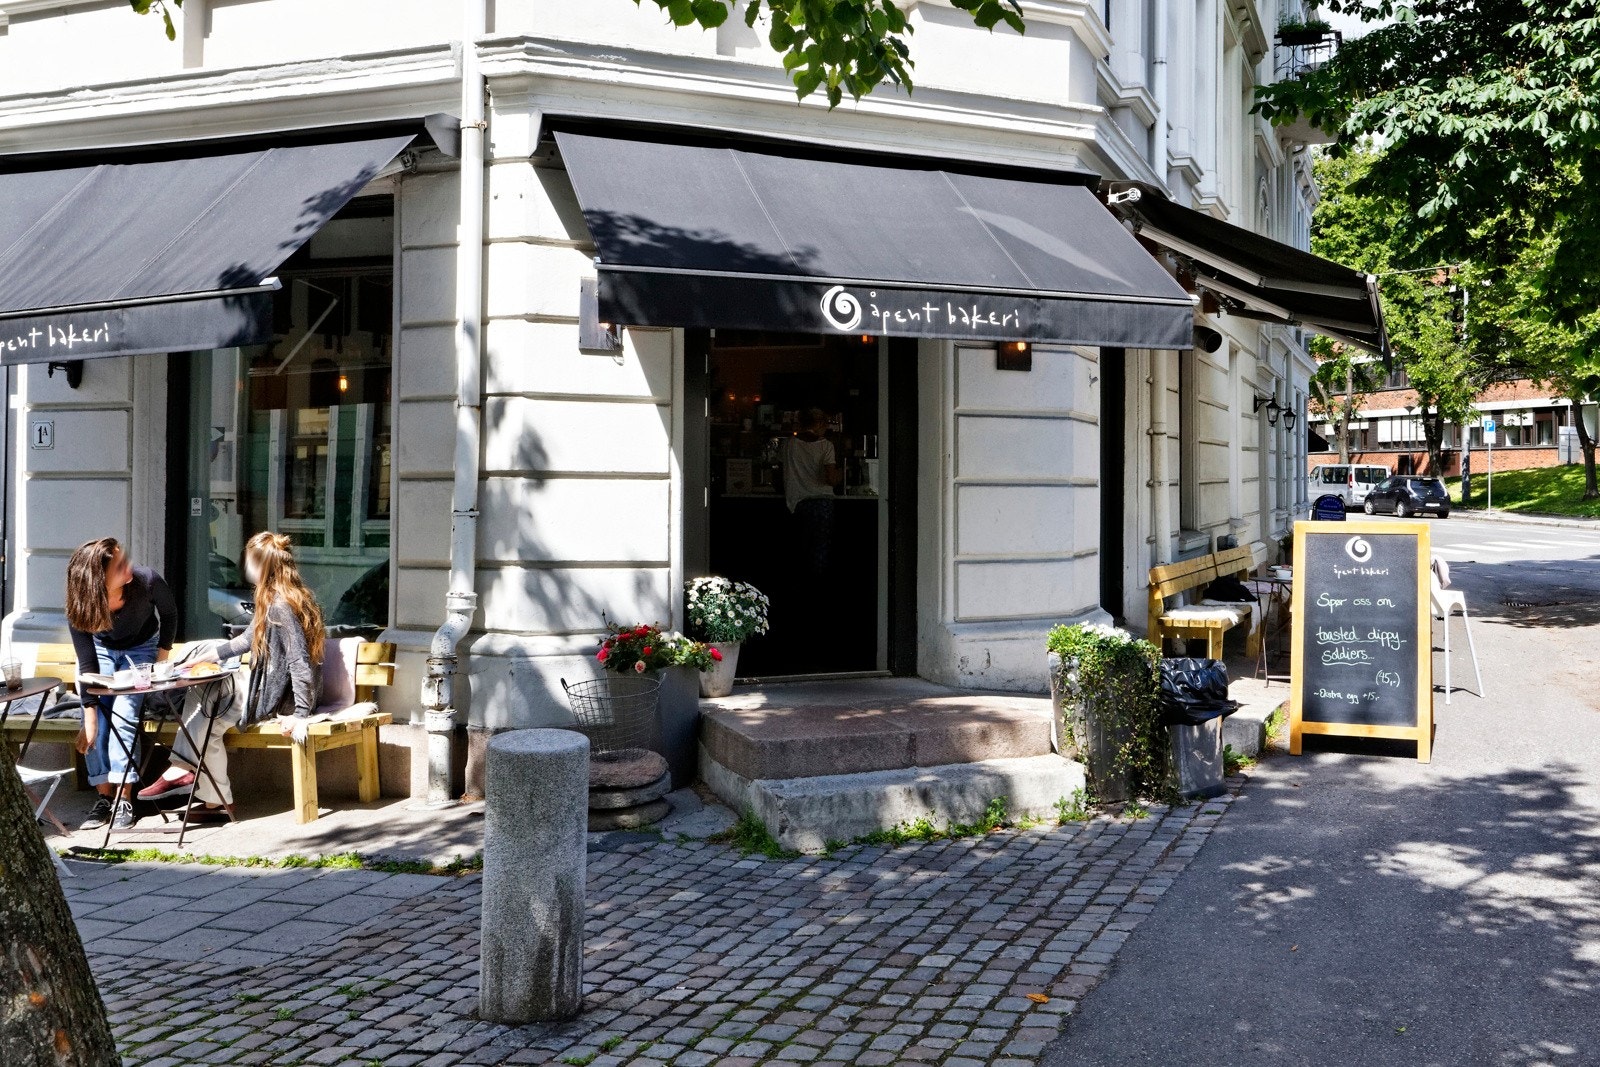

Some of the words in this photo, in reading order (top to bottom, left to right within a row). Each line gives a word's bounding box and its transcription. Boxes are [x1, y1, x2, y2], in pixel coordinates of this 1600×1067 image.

[947, 301, 1020, 330] bakeri
[48, 322, 109, 349] bakeri
[1486, 421, 1493, 431] P
[1353, 598, 1372, 606] oss
[1376, 598, 1396, 607] om
[1315, 626, 1361, 641] toasted
[1367, 626, 1401, 650] dippy
[1346, 692, 1360, 704] egg
